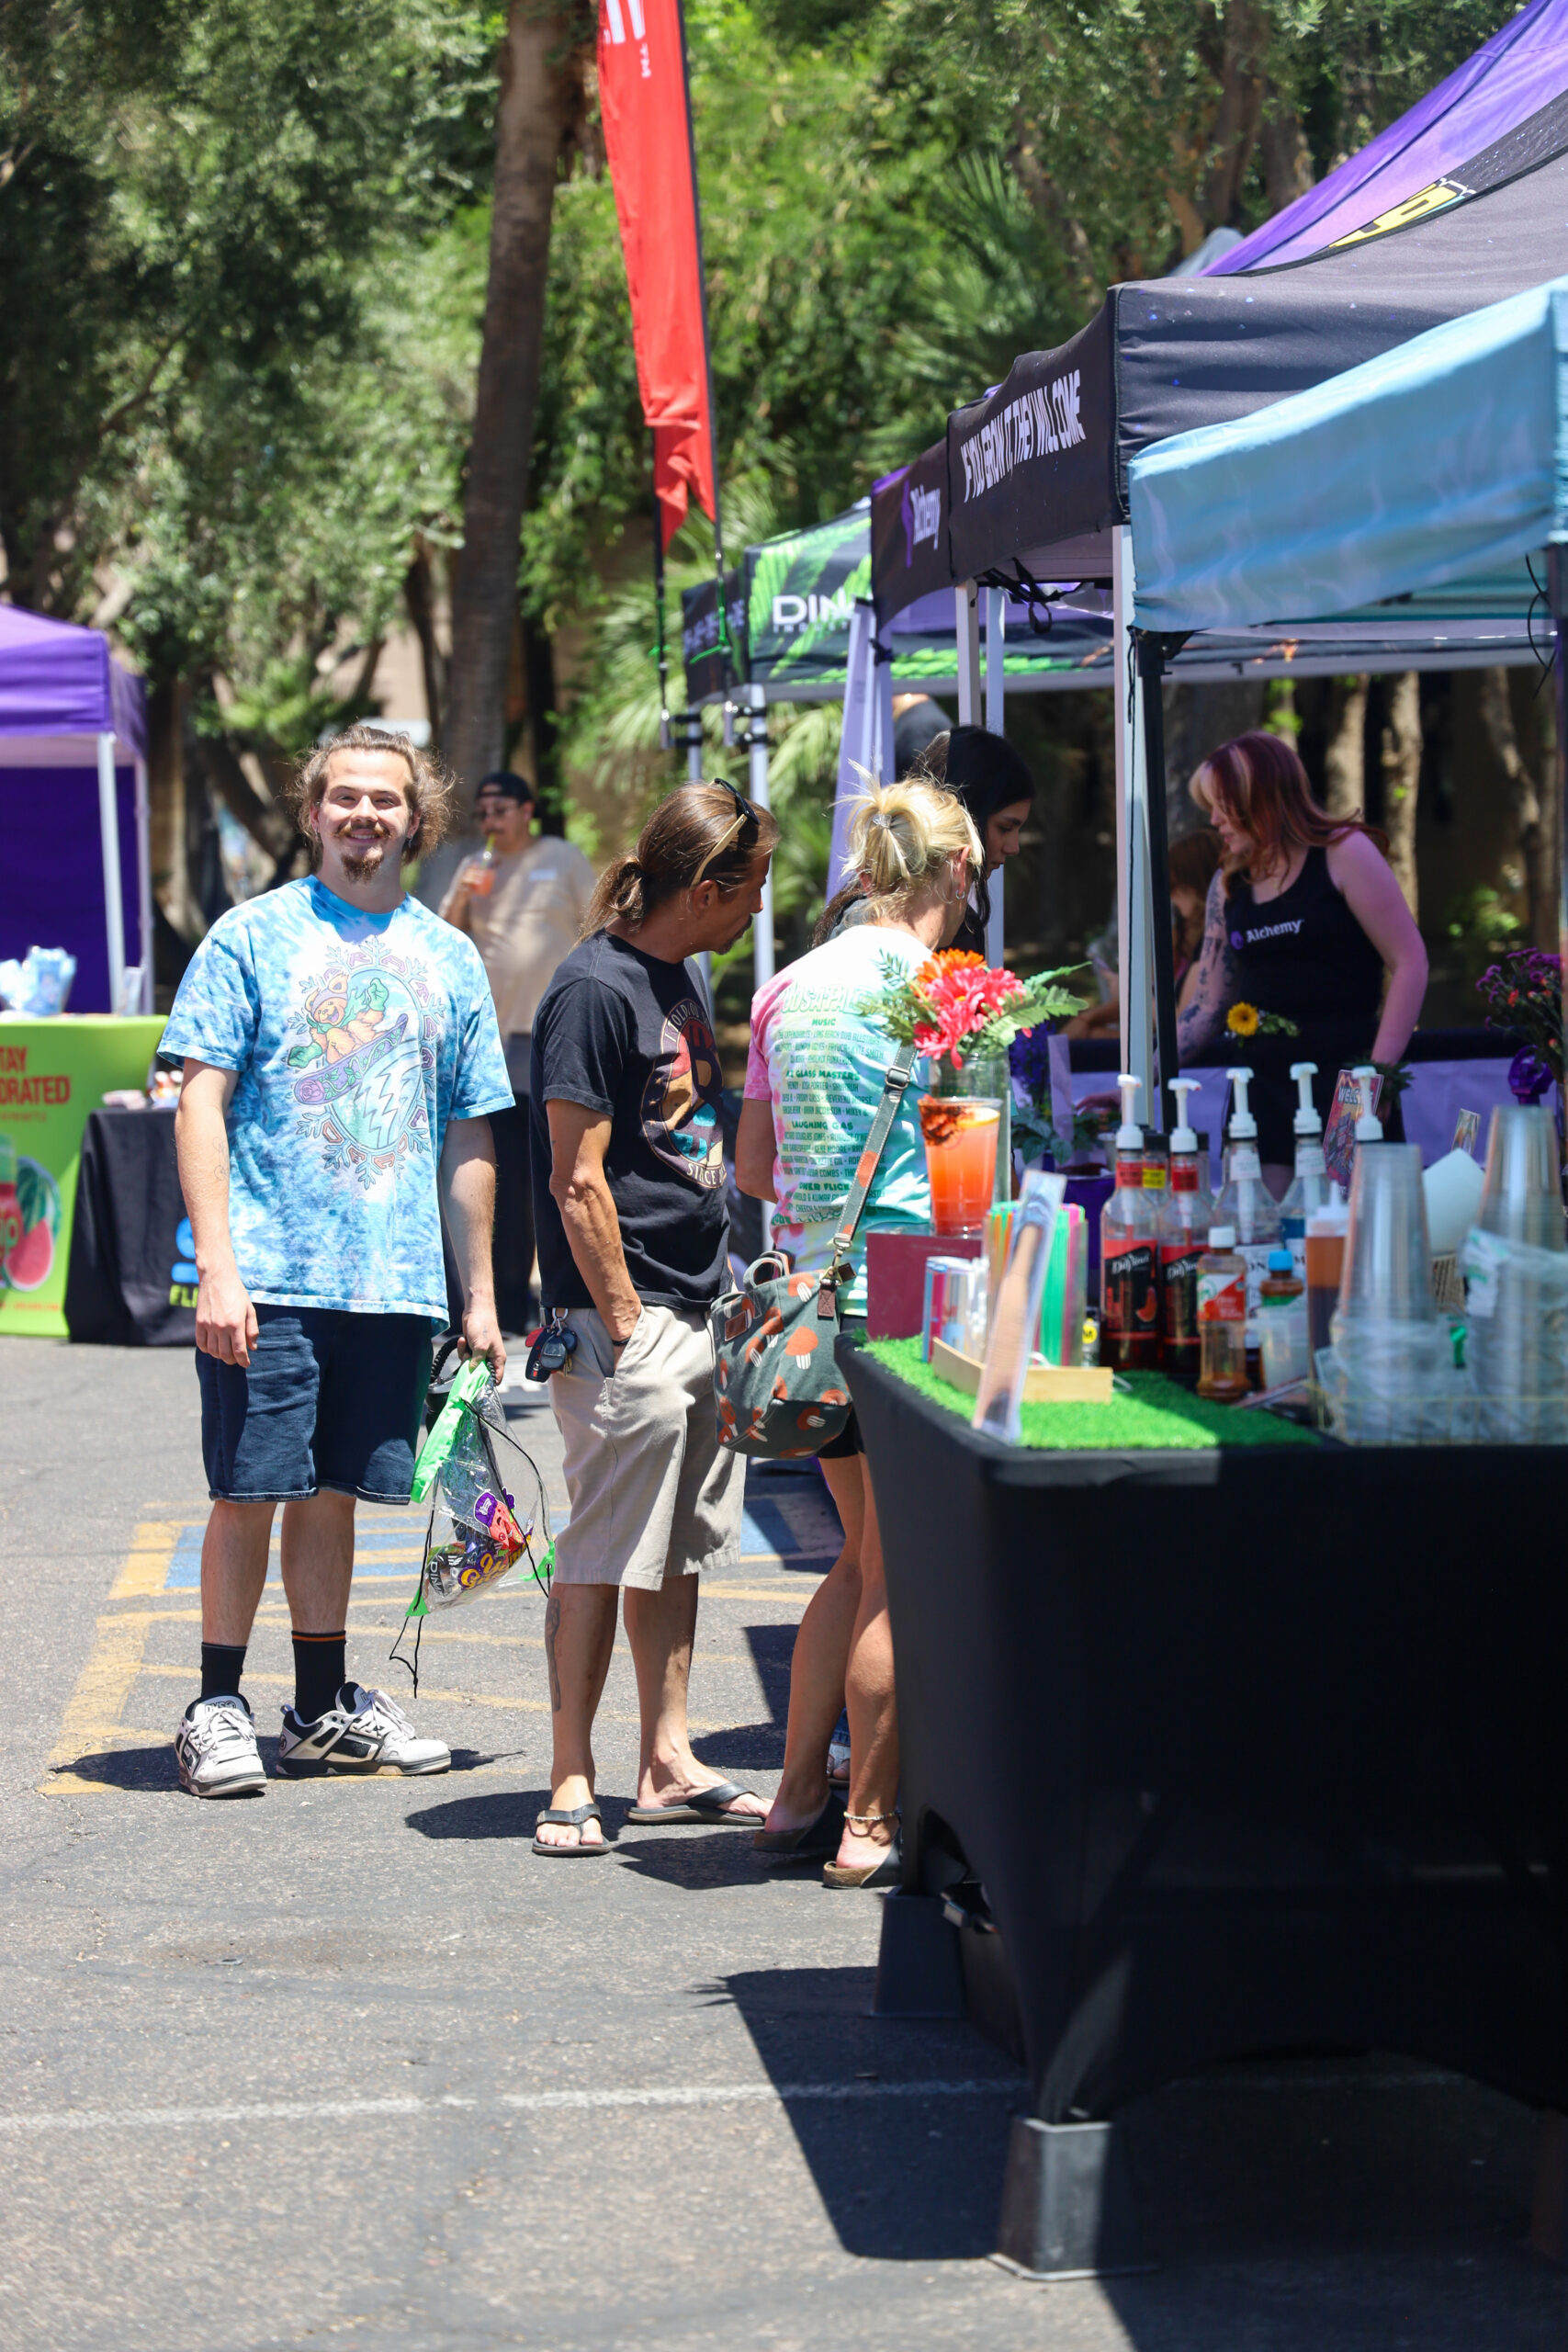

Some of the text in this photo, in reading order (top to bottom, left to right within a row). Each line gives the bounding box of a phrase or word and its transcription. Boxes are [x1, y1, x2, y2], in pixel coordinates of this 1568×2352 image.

[969, 434, 985, 499] YOU
[980, 412, 1006, 490] GROW
[1012, 395, 1033, 466] THEY
[1032, 385, 1059, 458] WILL
[1052, 368, 1087, 449] COME
[1247, 919, 1302, 943] Alchemy
[812, 1018, 836, 1026] MUSIC
[0, 1046, 28, 1073] TAY
[795, 1069, 817, 1078] GLASS
[818, 1069, 860, 1080] MASTERS
[0, 1076, 72, 1105] DRATED
[792, 1121, 828, 1130] LAUGHING
[686, 1162, 716, 1185] SINCE
